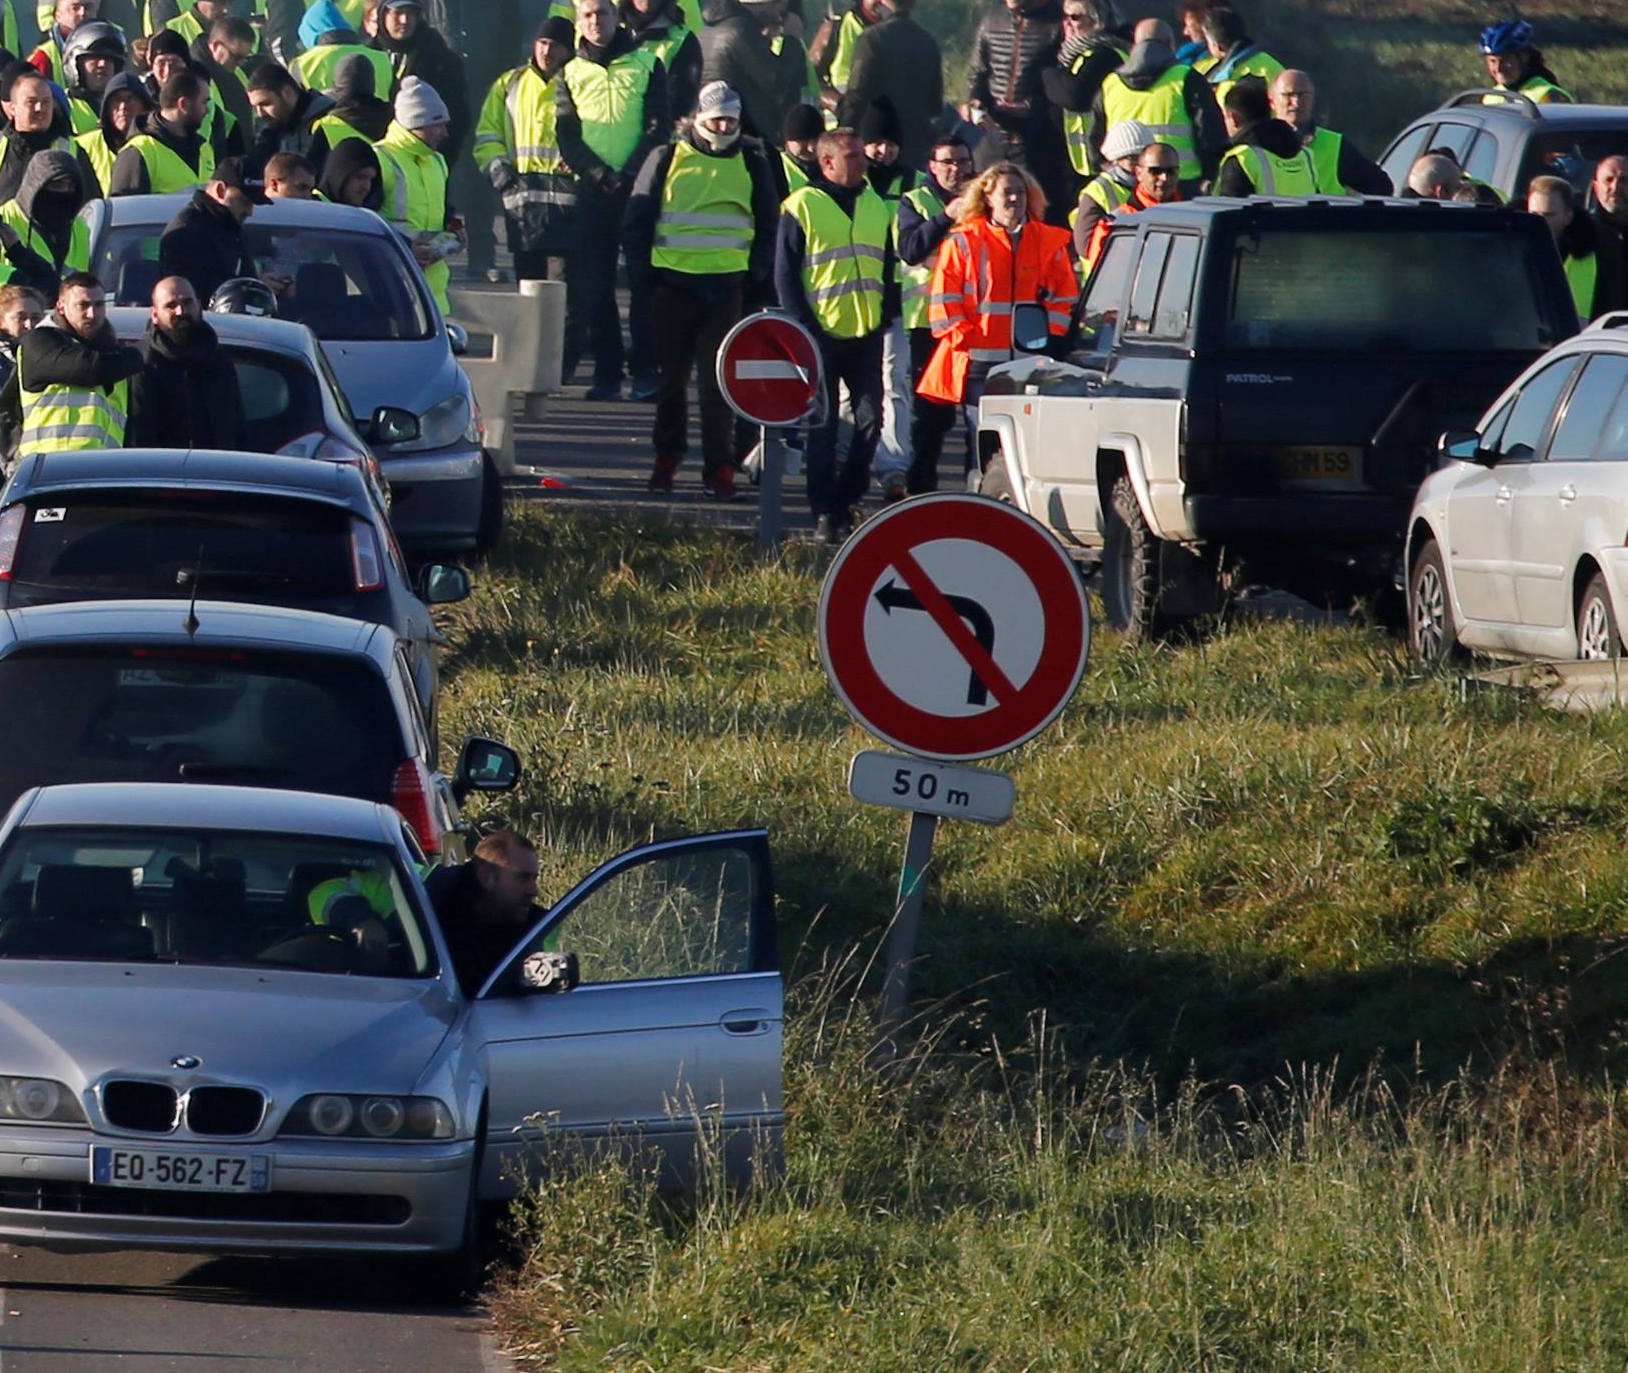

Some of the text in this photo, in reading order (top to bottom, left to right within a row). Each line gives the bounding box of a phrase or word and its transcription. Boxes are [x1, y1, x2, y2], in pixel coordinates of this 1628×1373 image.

[1225, 373, 1274, 384] PATROL
[1324, 450, 1351, 473] 59
[892, 768, 970, 807] 50 m
